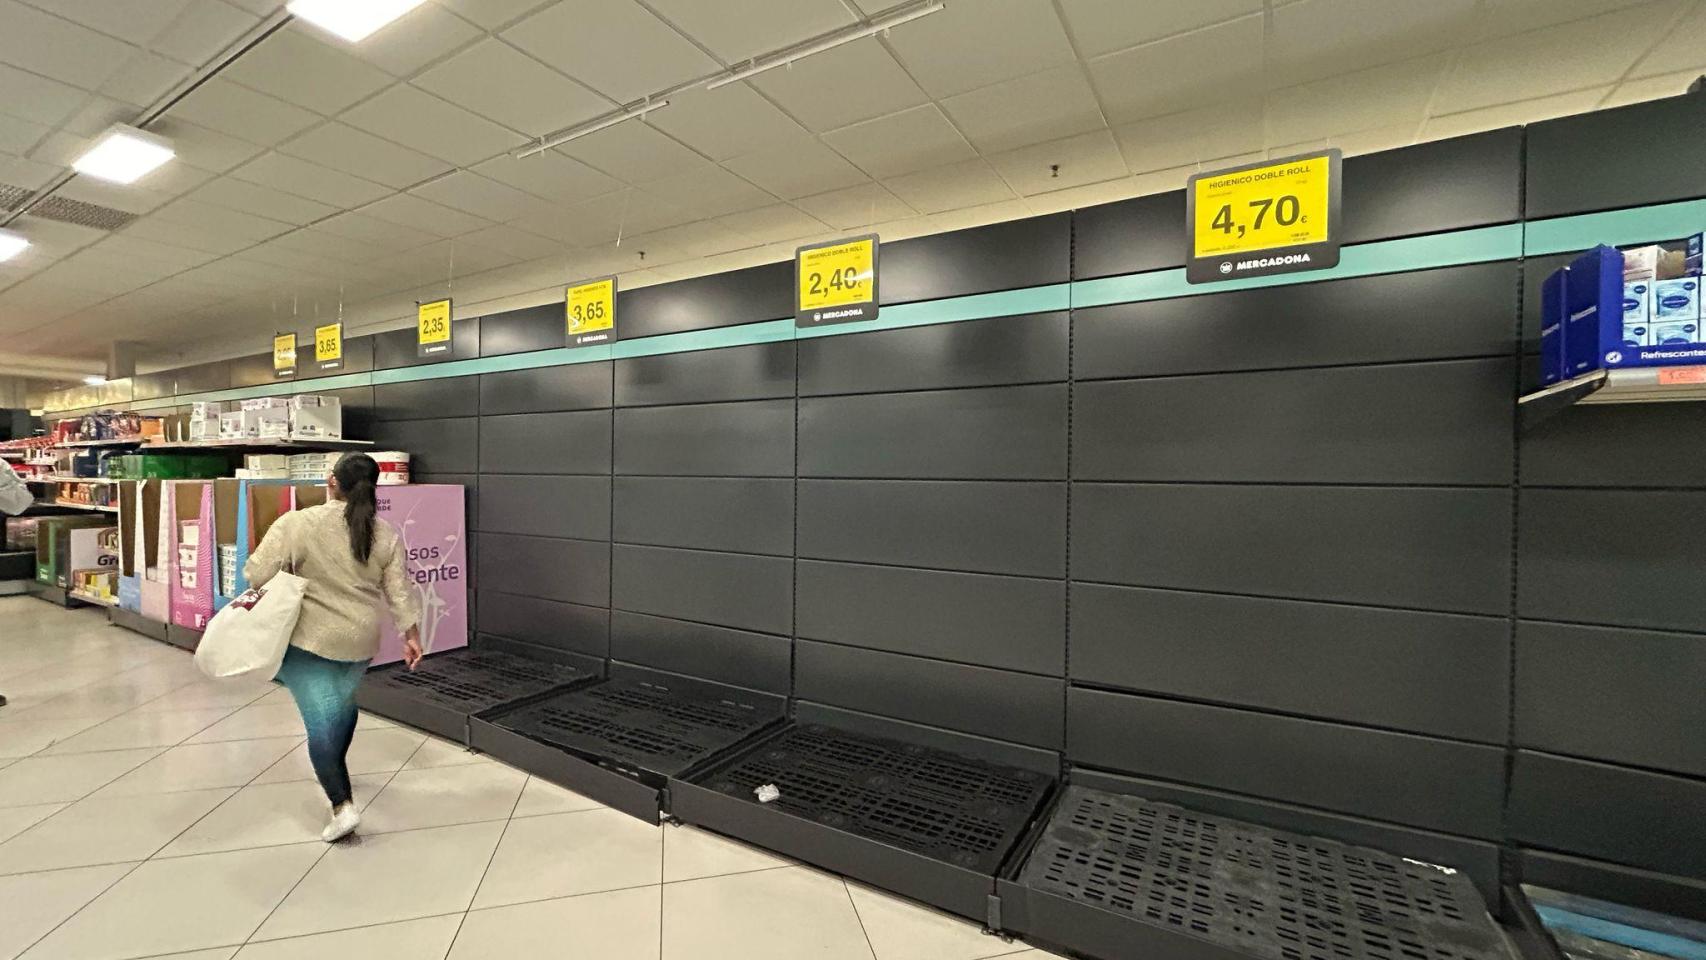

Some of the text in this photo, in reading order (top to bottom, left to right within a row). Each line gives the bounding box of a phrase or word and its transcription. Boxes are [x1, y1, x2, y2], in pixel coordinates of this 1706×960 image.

[1208, 176, 1253, 190] HIGIENICO
[1254, 170, 1284, 182] DOBLE
[1286, 165, 1311, 177] ROLL
[1236, 252, 1311, 271] MERCADONA
[822, 308, 863, 319] MERCADONA
[318, 338, 337, 354] 3,65
[1640, 349, 1706, 360] Refrescantes
[97, 554, 119, 566] Gr
[405, 546, 439, 561] sos
[407, 563, 459, 585] tente
